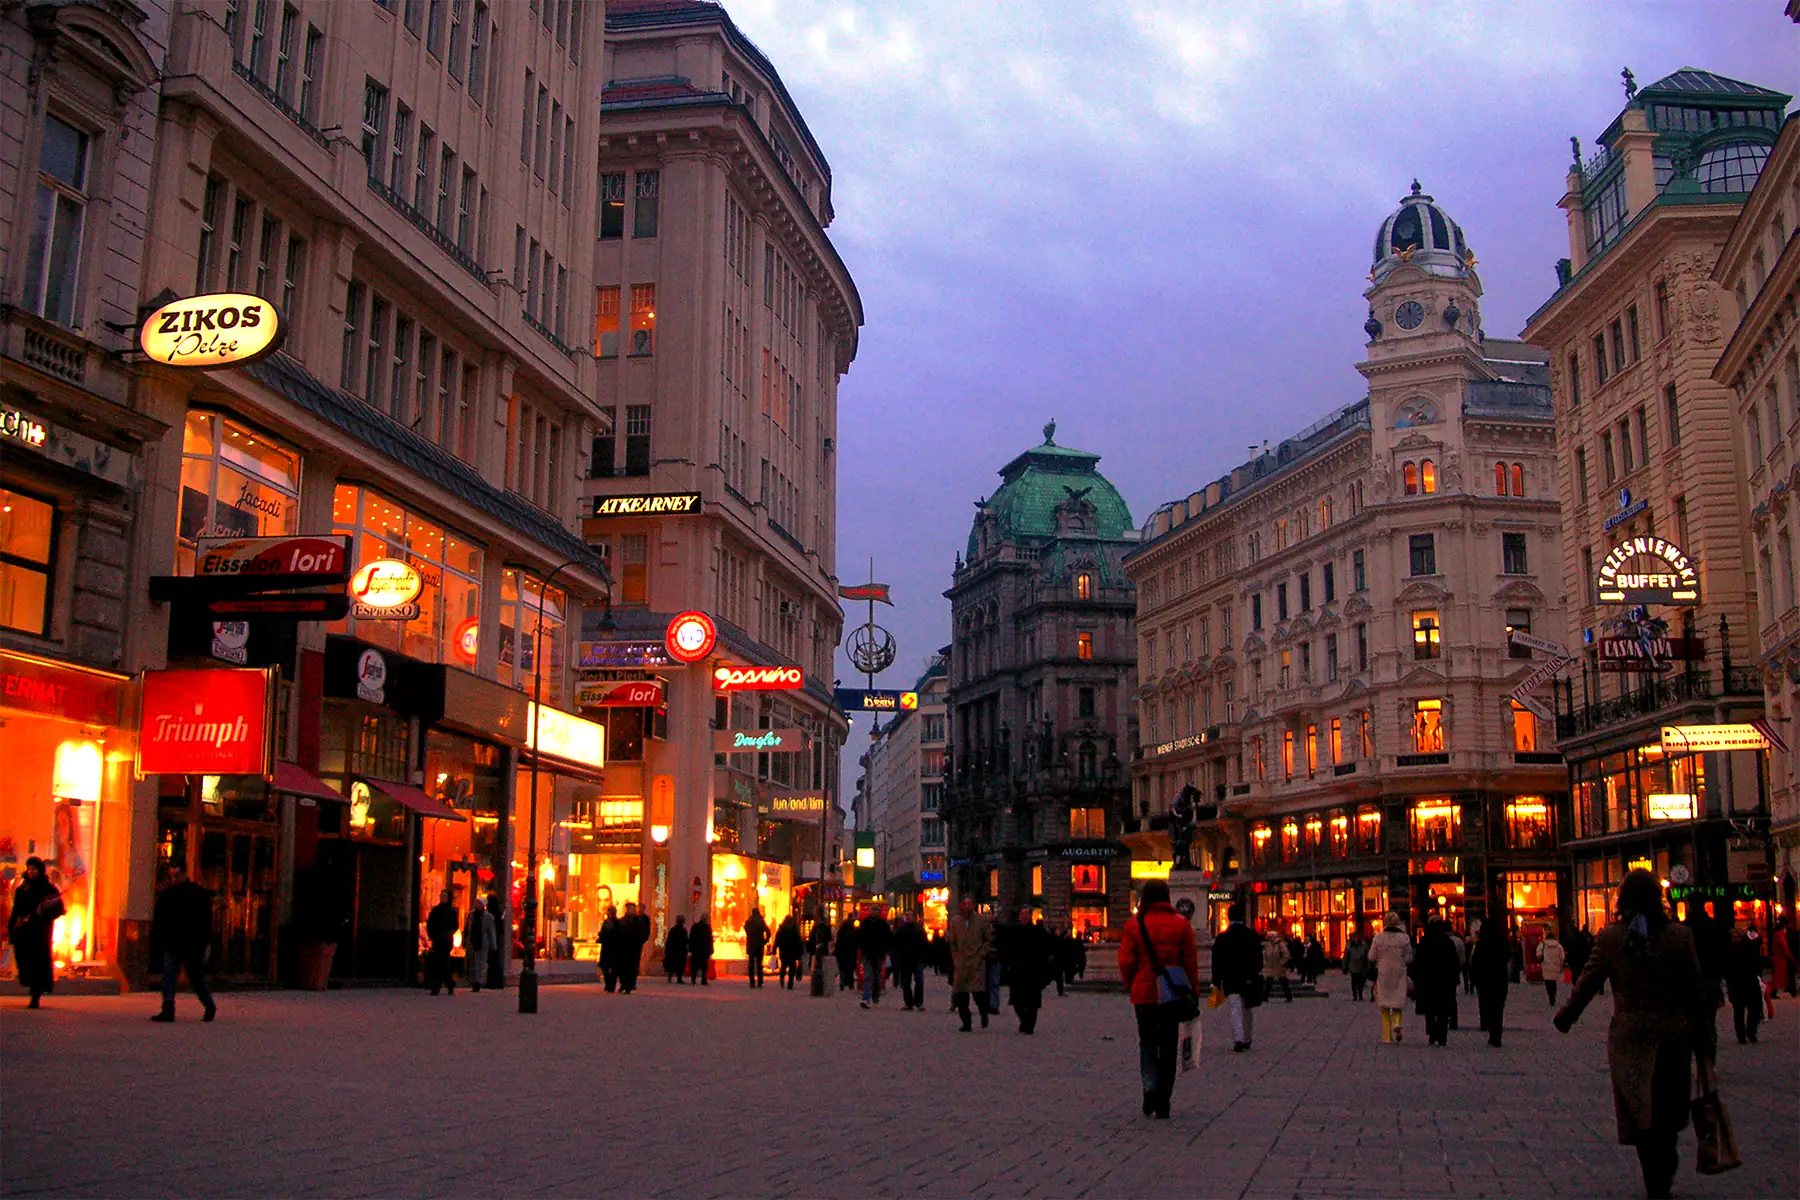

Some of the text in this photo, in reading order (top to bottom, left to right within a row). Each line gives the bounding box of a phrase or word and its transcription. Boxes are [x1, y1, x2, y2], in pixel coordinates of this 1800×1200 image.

[158, 305, 261, 333] ZIKOS
[168, 332, 238, 361] Pelze
[234, 481, 281, 518] jacadi
[596, 496, 698, 513] ATKEARNEY
[202, 555, 280, 573] Eissalon
[1598, 537, 1697, 588] TRZESNIEWSKI
[1617, 574, 1678, 588] BUFFET
[355, 604, 412, 617] ESPRESSO
[153, 714, 248, 748] Triumph
[734, 731, 782, 749] Douglas
[1062, 848, 1118, 857] AUGARTEN
